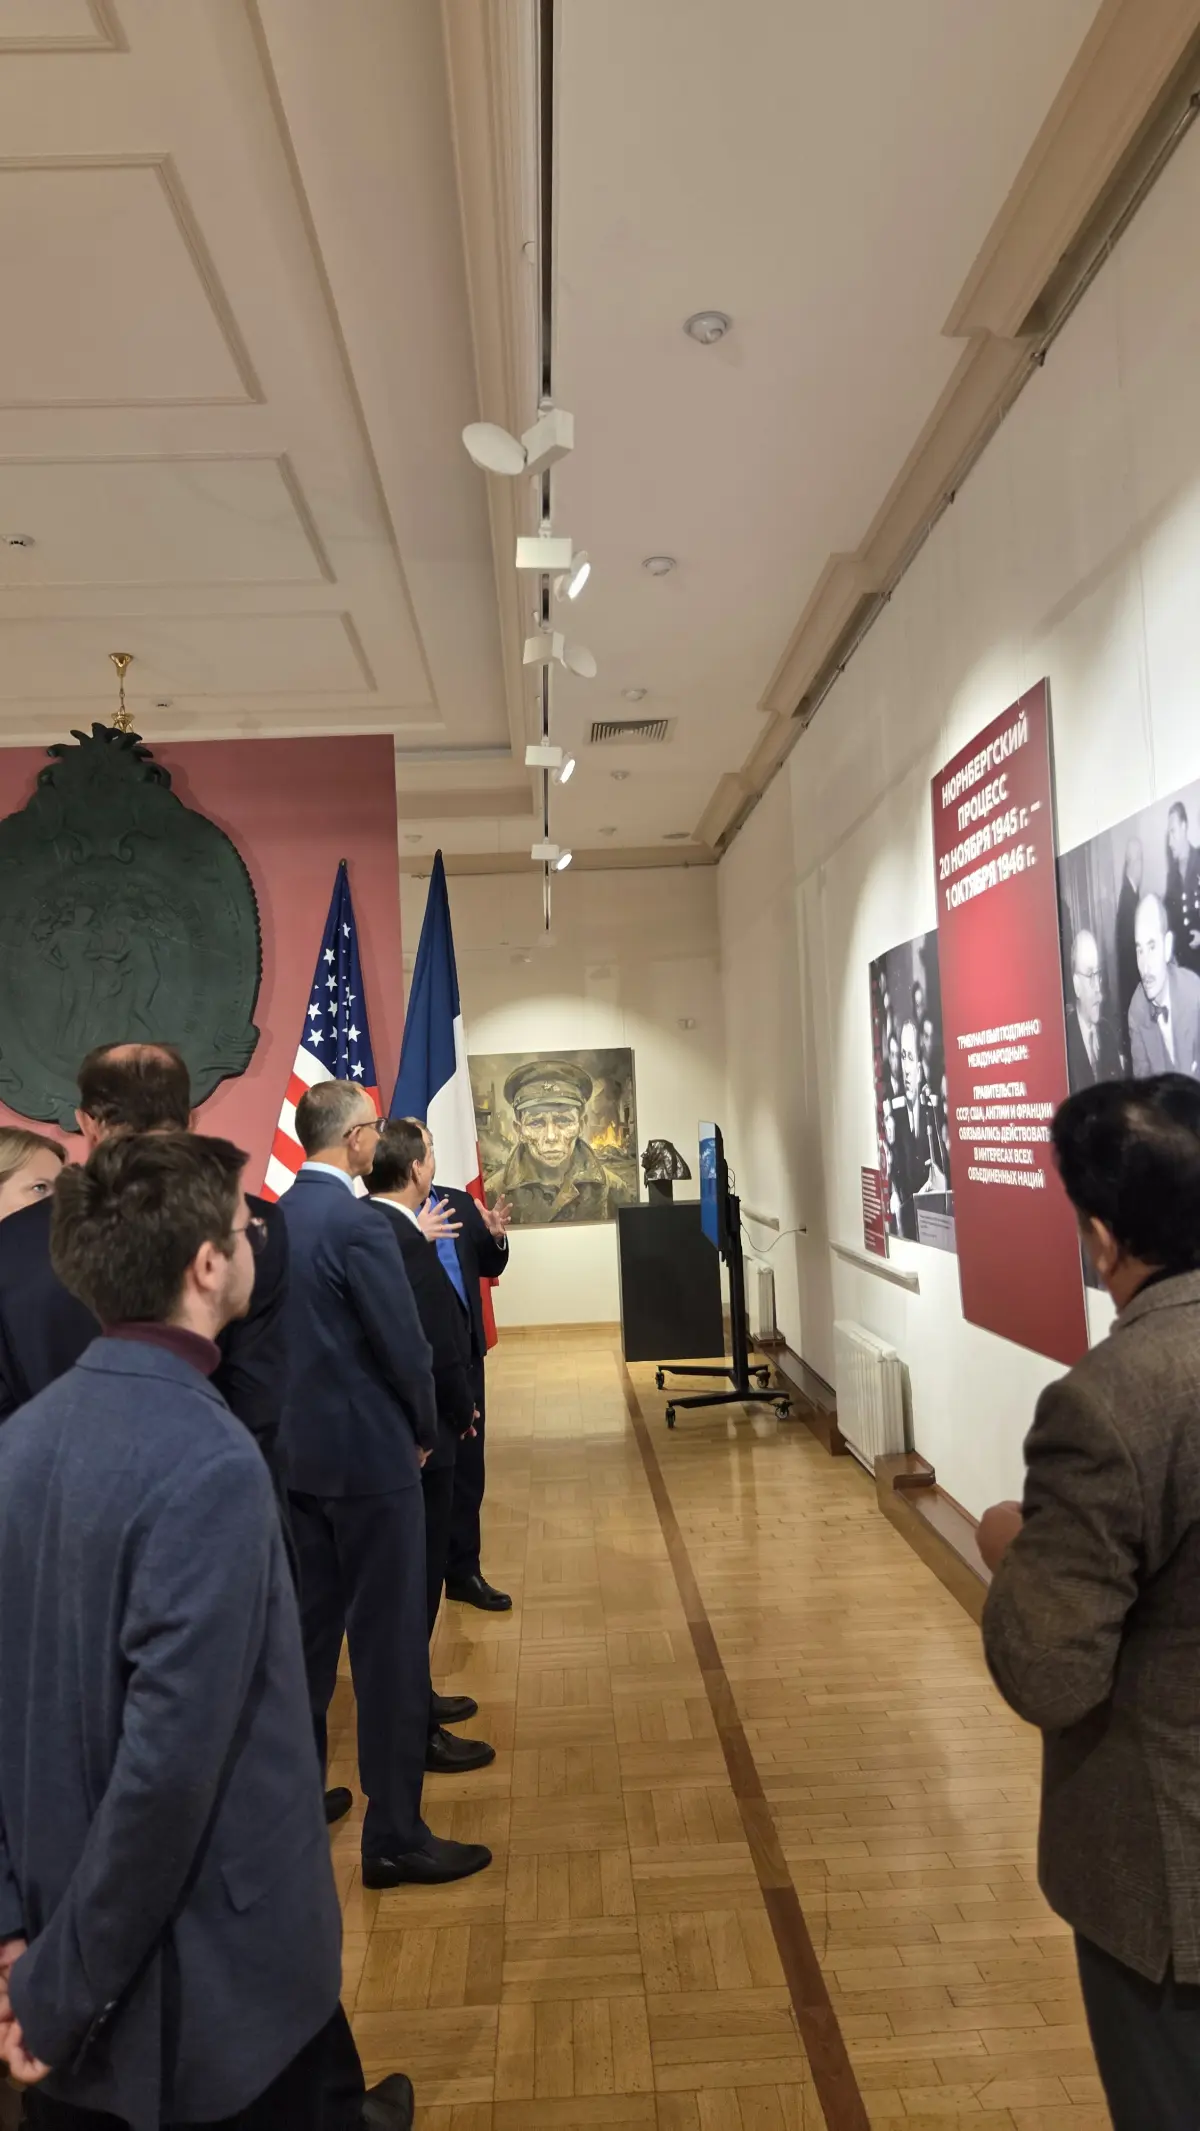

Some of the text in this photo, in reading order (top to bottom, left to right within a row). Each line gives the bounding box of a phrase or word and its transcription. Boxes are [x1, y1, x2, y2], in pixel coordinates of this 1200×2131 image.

[942, 710, 1029, 809] НЮРНБЕРГСКИЙ
[957, 772, 1008, 831] ПРОЦЕСС
[939, 854, 950, 880] 20
[950, 831, 992, 871] НОЯБРЯ
[991, 806, 1019, 846] 1945
[1019, 807, 1030, 829] г.
[951, 860, 997, 908] ОКТЯБРЯ
[996, 844, 1026, 882] 1946
[1026, 845, 1037, 868] г.
[1016, 1102, 1053, 1121] ФРАНЦИИ
[978, 1147, 1013, 1163] ИНТЕРЕСАХ
[1013, 1149, 1033, 1164] ВСЕХ
[1017, 1168, 1045, 1190] НАЦИЙ
